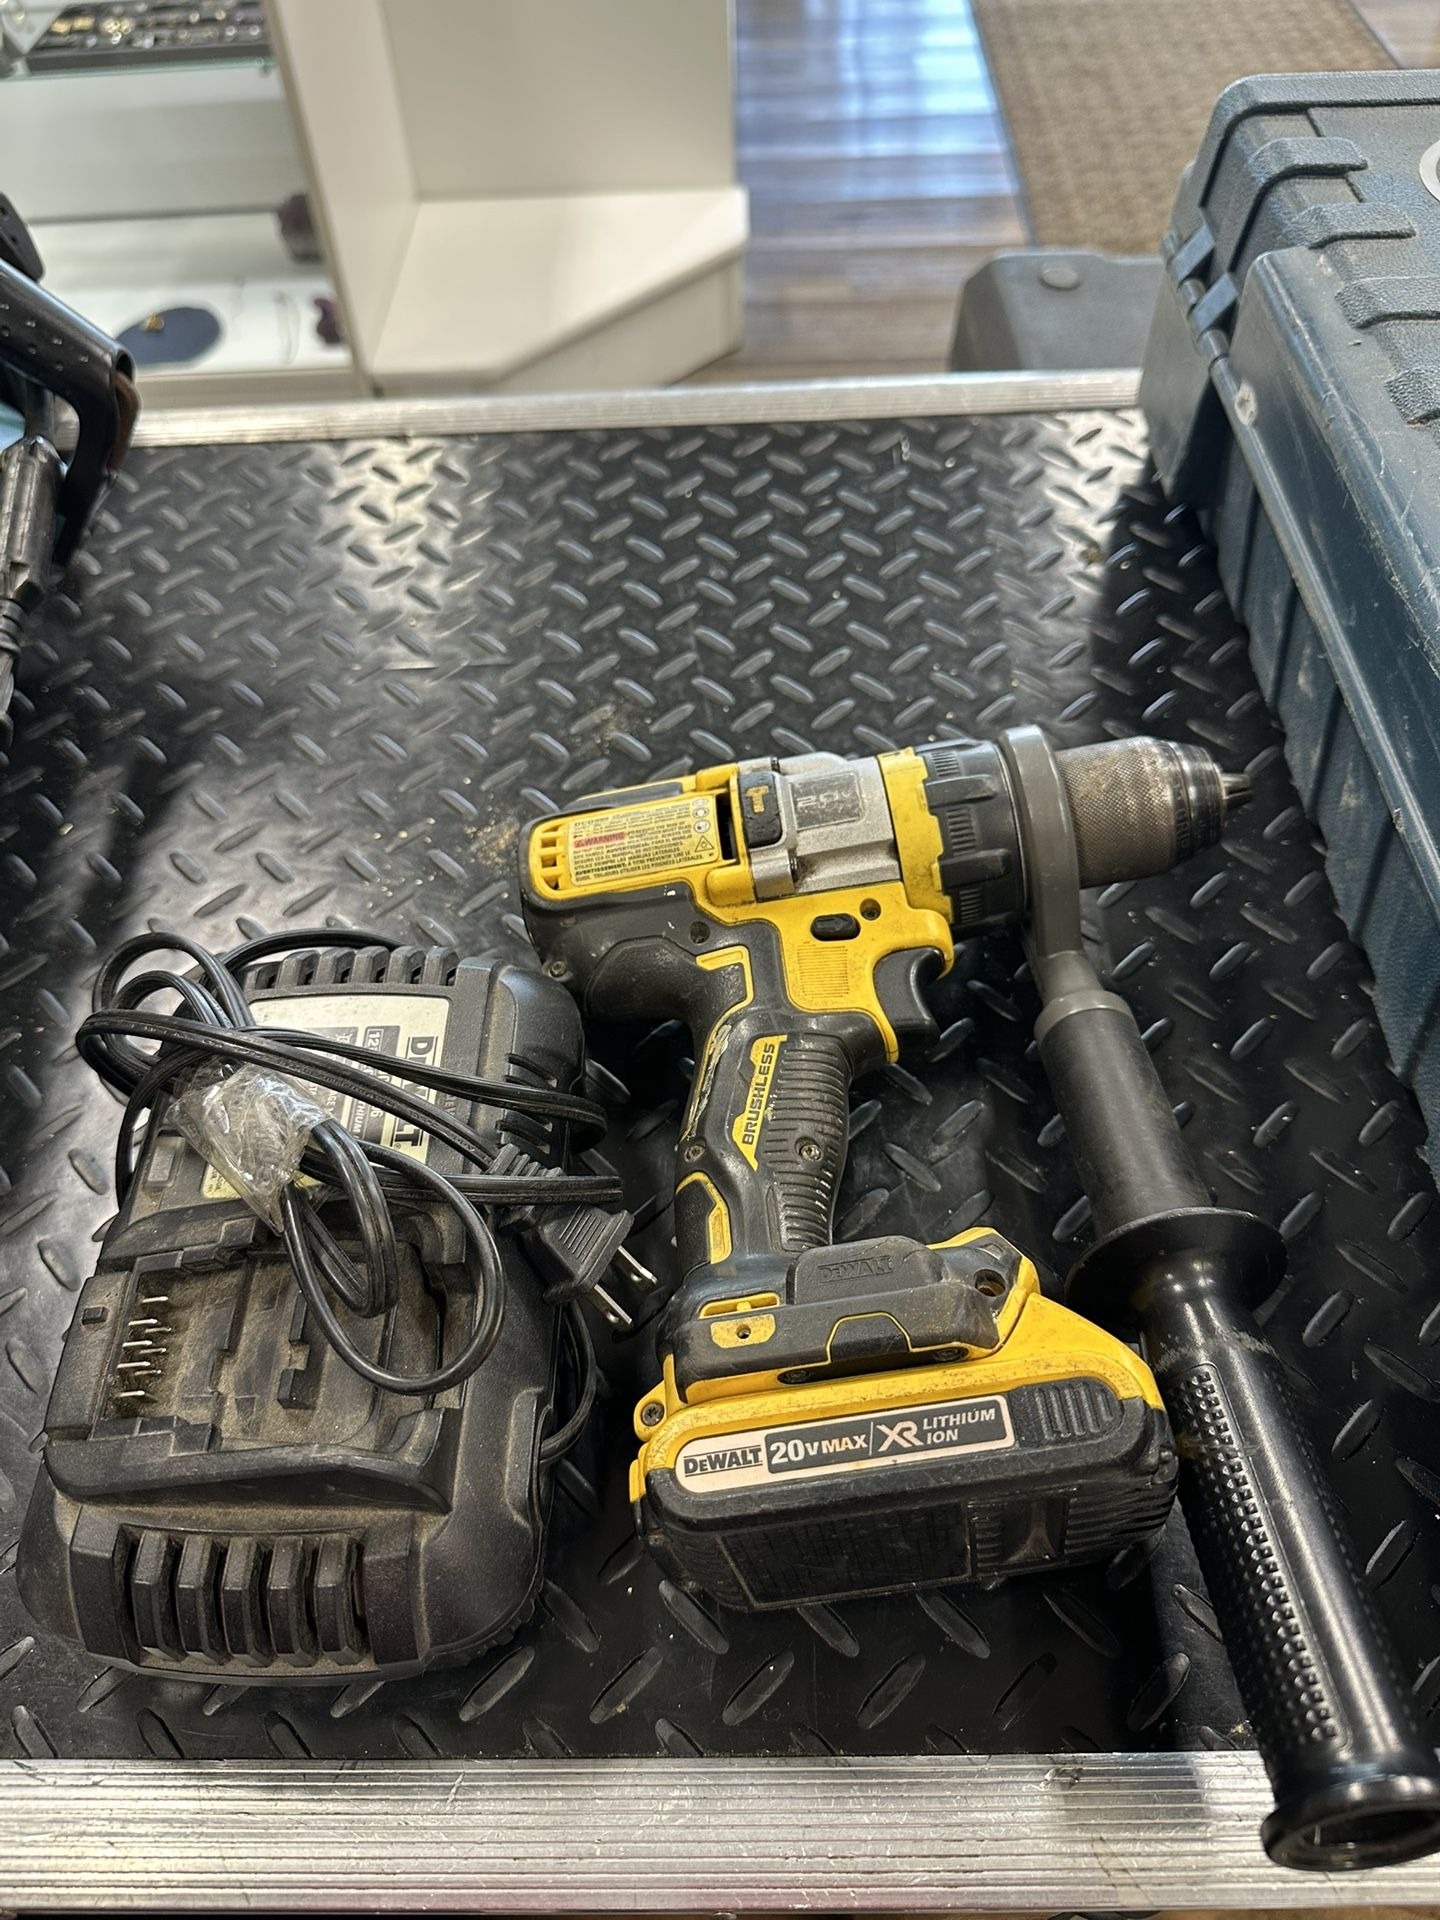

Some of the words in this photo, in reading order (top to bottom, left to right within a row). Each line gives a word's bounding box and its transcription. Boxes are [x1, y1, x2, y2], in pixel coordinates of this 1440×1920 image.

[742, 1043, 775, 1146] BRUSHLESS
[922, 1407, 996, 1431] LITHIUM
[876, 1420, 924, 1452] XR
[926, 1428, 959, 1445] ION
[683, 1446, 762, 1475] DEWALT
